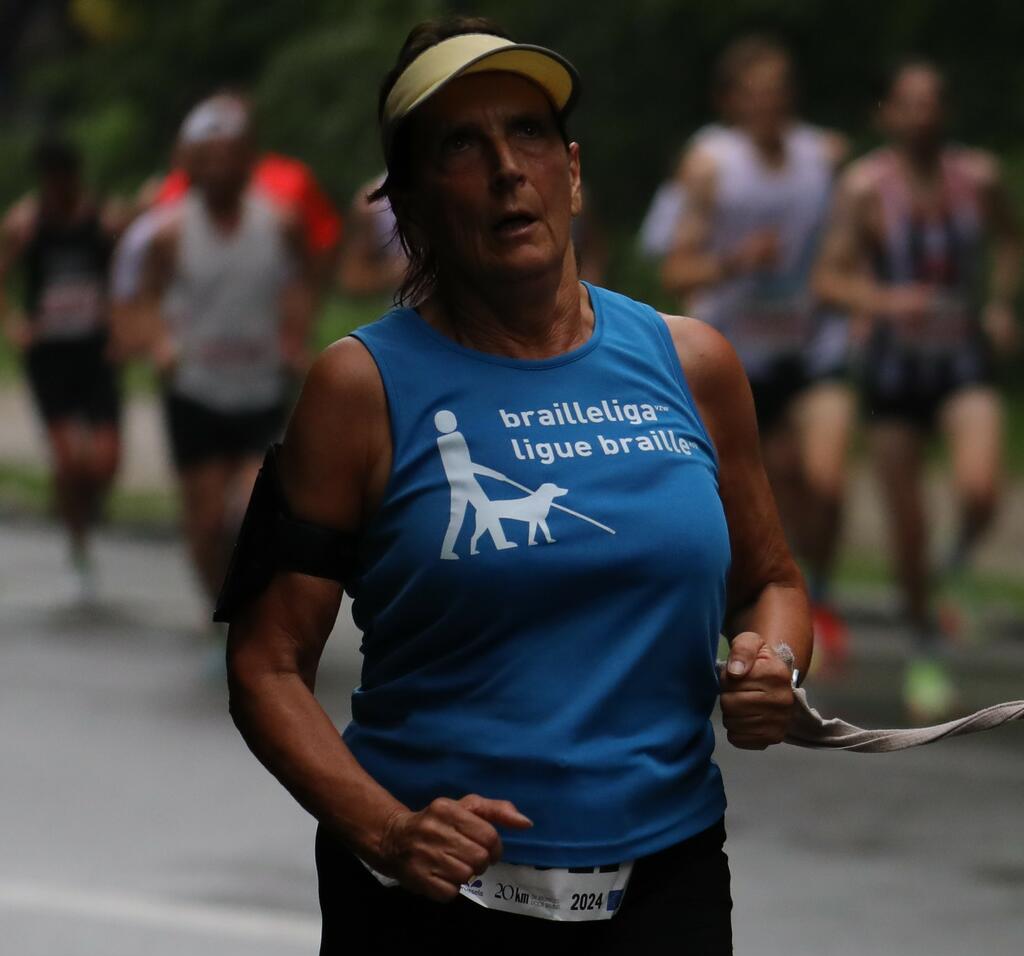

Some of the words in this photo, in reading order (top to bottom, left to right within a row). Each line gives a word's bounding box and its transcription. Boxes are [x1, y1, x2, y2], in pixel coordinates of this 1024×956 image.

[499, 400, 658, 428] brailleliga
[511, 438, 593, 465] ligue
[597, 430, 692, 456] braille
[570, 892, 604, 911] 2024
